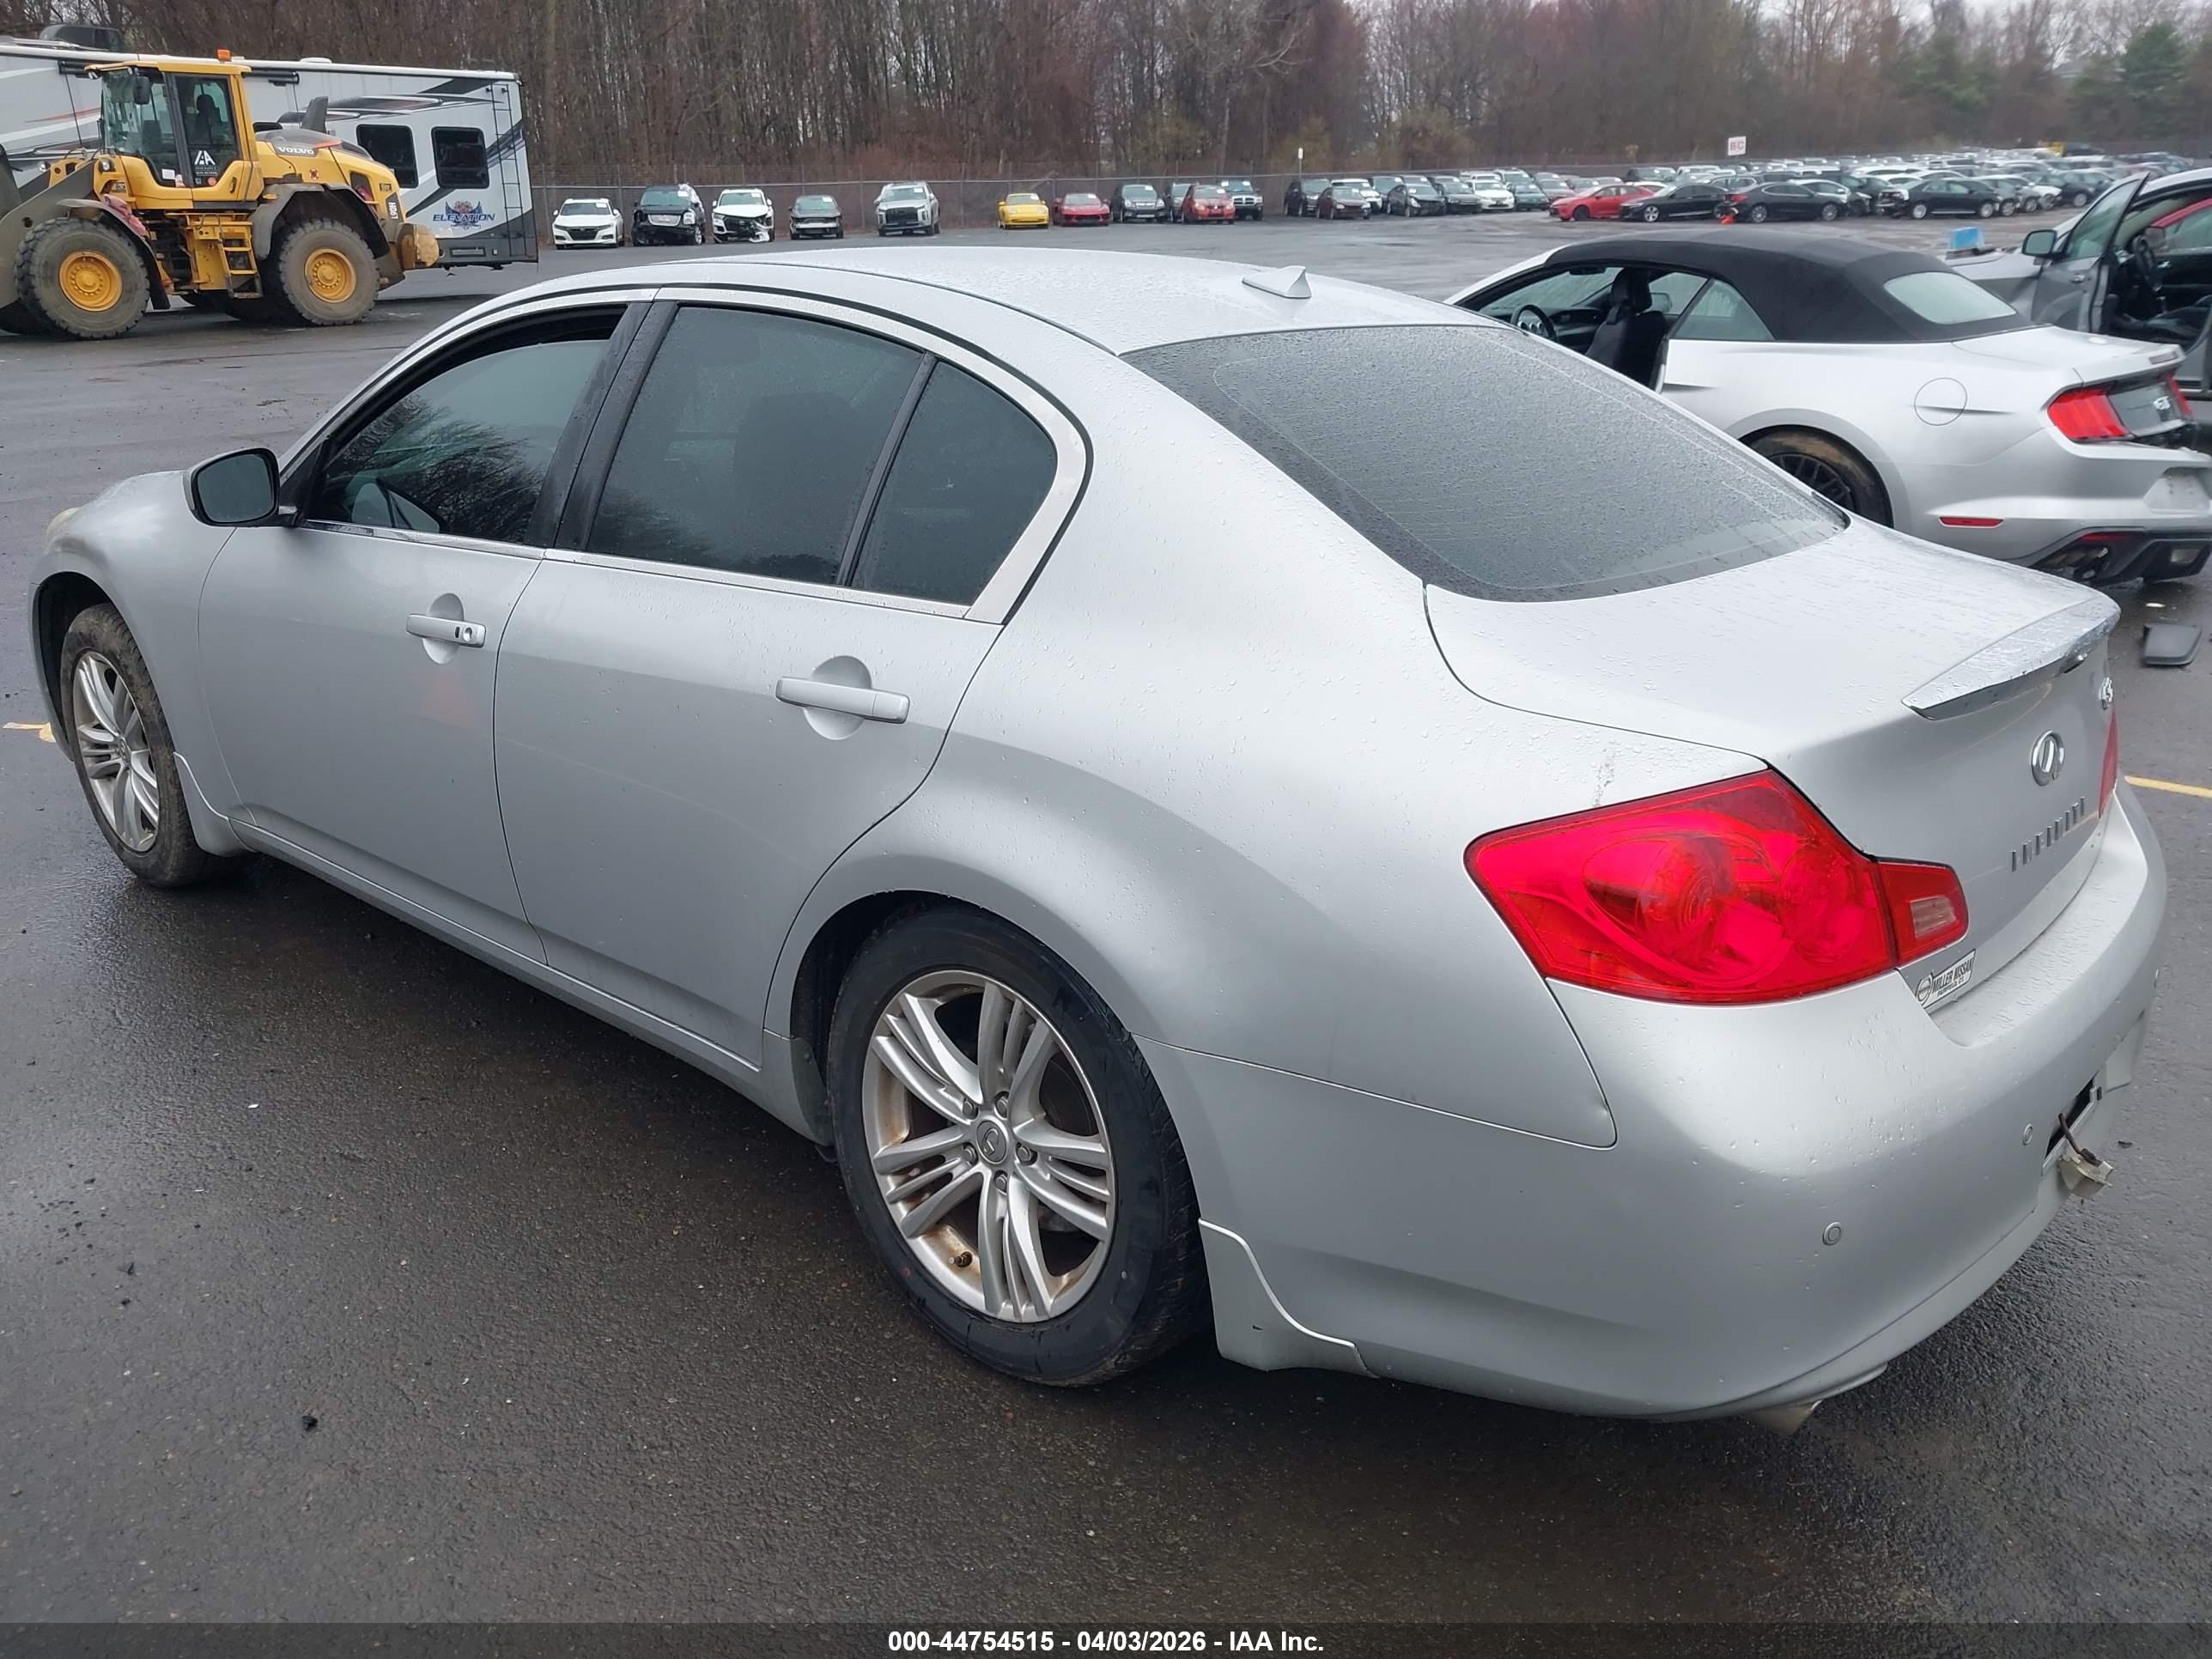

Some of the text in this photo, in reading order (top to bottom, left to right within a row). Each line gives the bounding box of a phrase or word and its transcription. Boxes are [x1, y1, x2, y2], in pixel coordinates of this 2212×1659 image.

[276, 146, 314, 155] VOLVO
[388, 202, 398, 220] L90H
[432, 213, 495, 222] ELEVATION
[2011, 795, 2086, 873] INFINITI
[1932, 970, 1954, 994] MILLER
